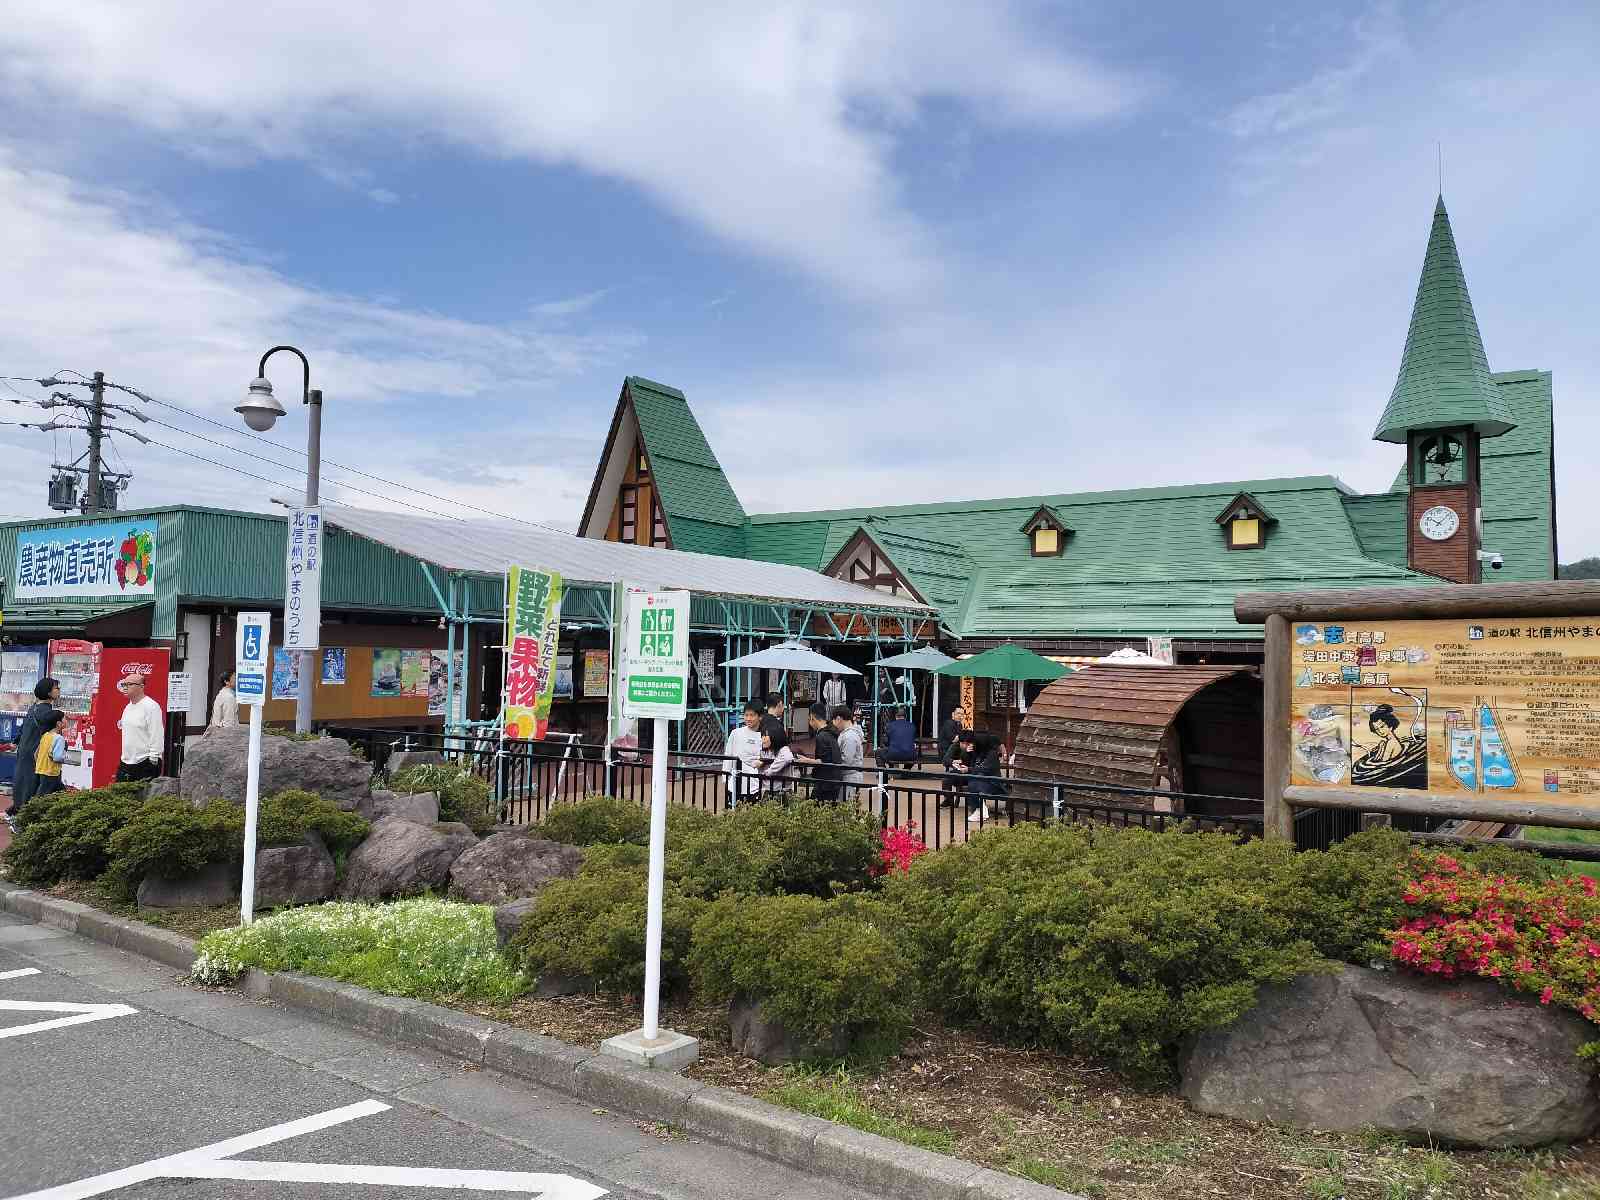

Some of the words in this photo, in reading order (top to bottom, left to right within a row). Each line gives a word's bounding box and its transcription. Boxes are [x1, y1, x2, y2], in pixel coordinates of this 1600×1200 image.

[19, 537, 115, 586] 農産物直売所
[288, 511, 305, 645] 北信州やまのうち
[1487, 627, 1521, 639] 道の駅
